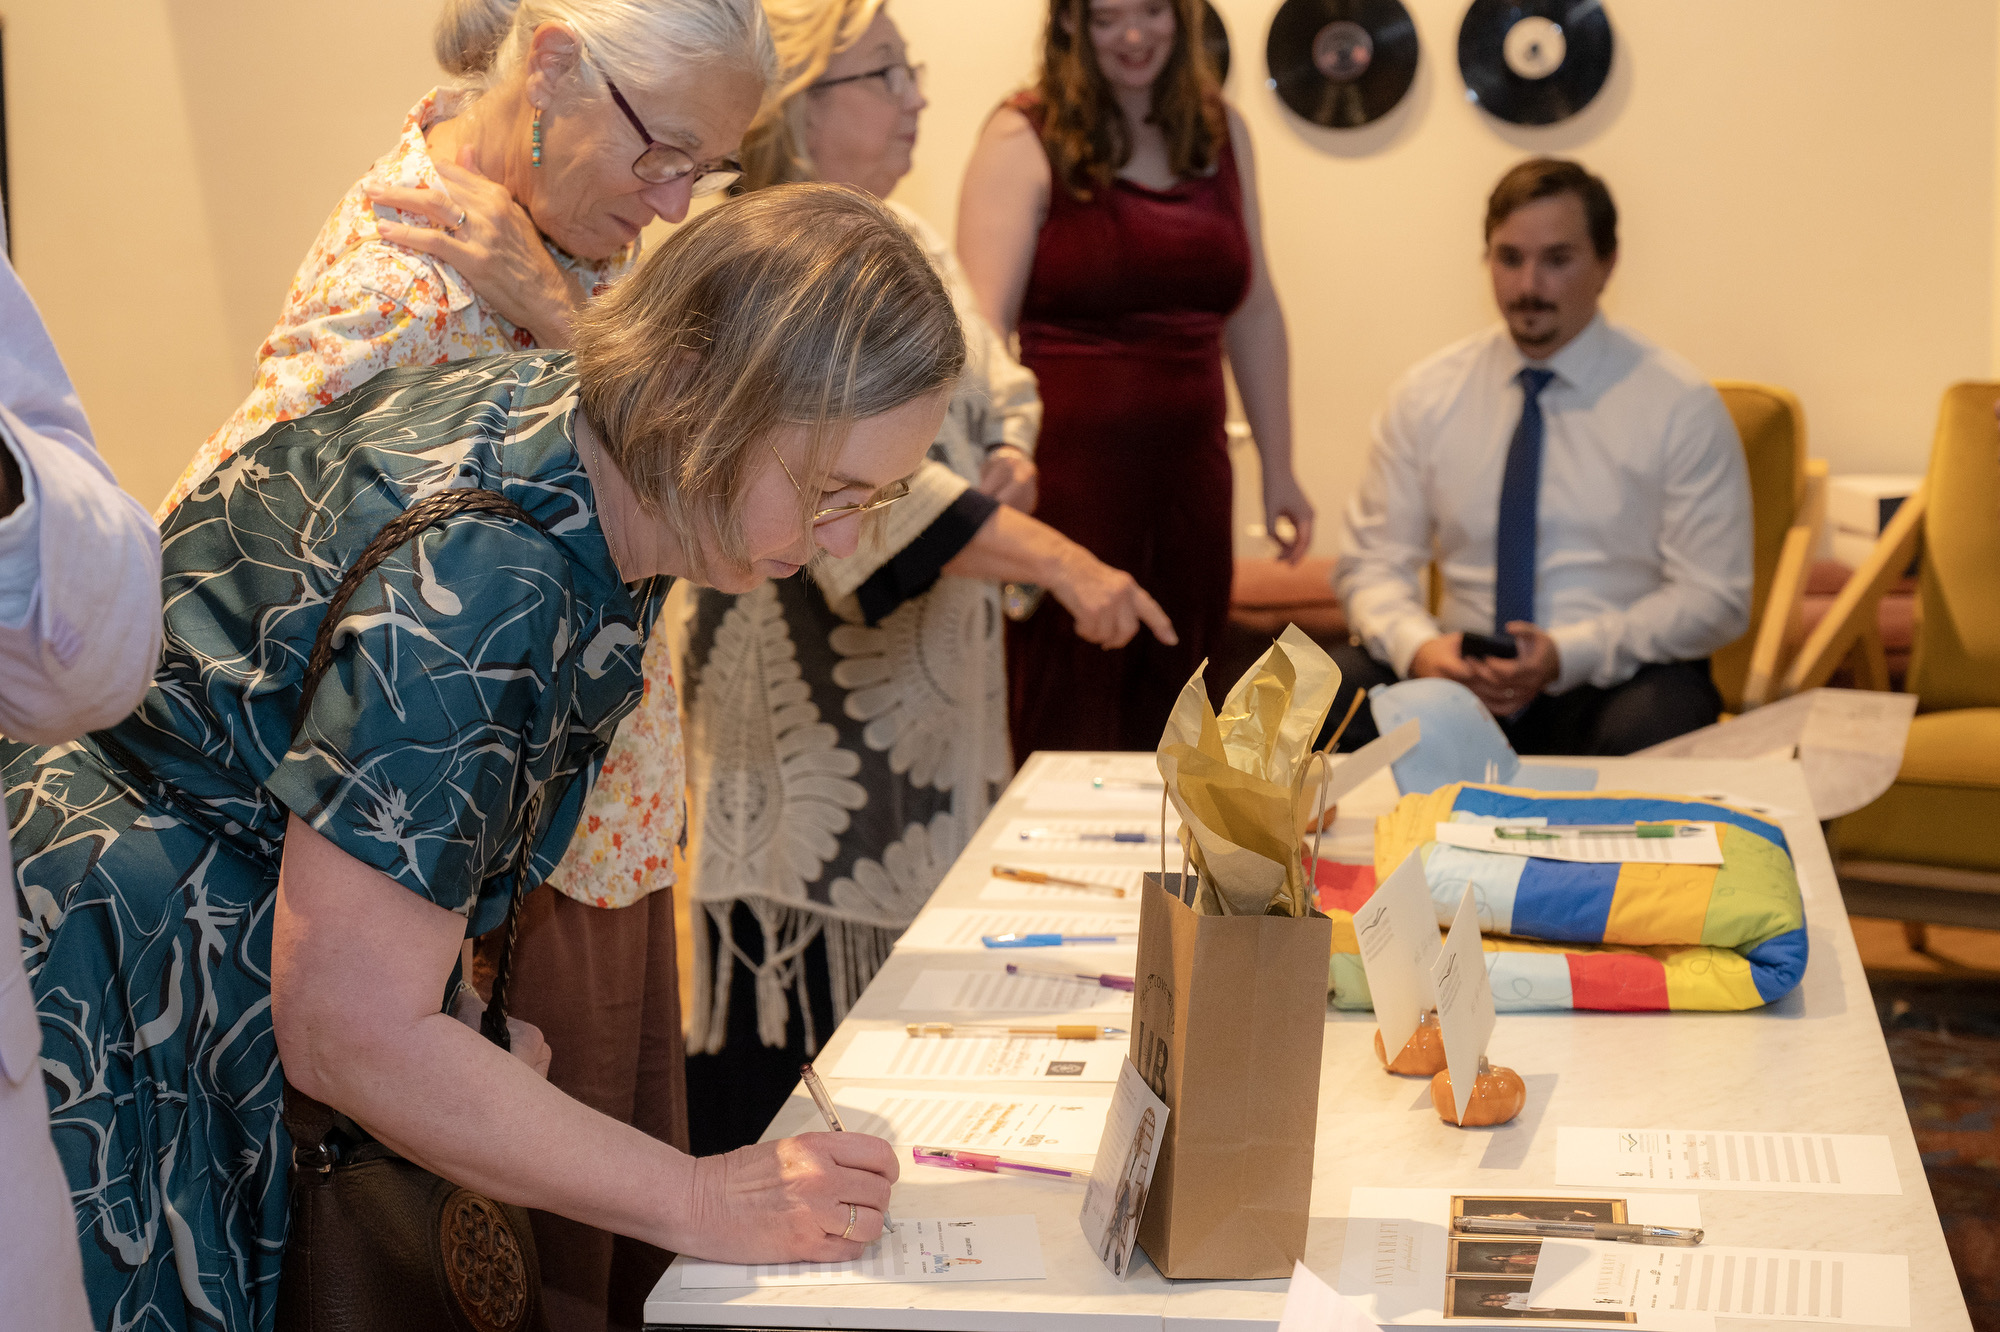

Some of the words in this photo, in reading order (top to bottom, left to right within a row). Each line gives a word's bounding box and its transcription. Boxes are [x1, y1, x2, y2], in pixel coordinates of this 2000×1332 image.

[1378, 1222, 1400, 1255] KRAFT
[1374, 1258, 1396, 1287] ANNA
[1599, 1252, 1617, 1275] KRAFT
